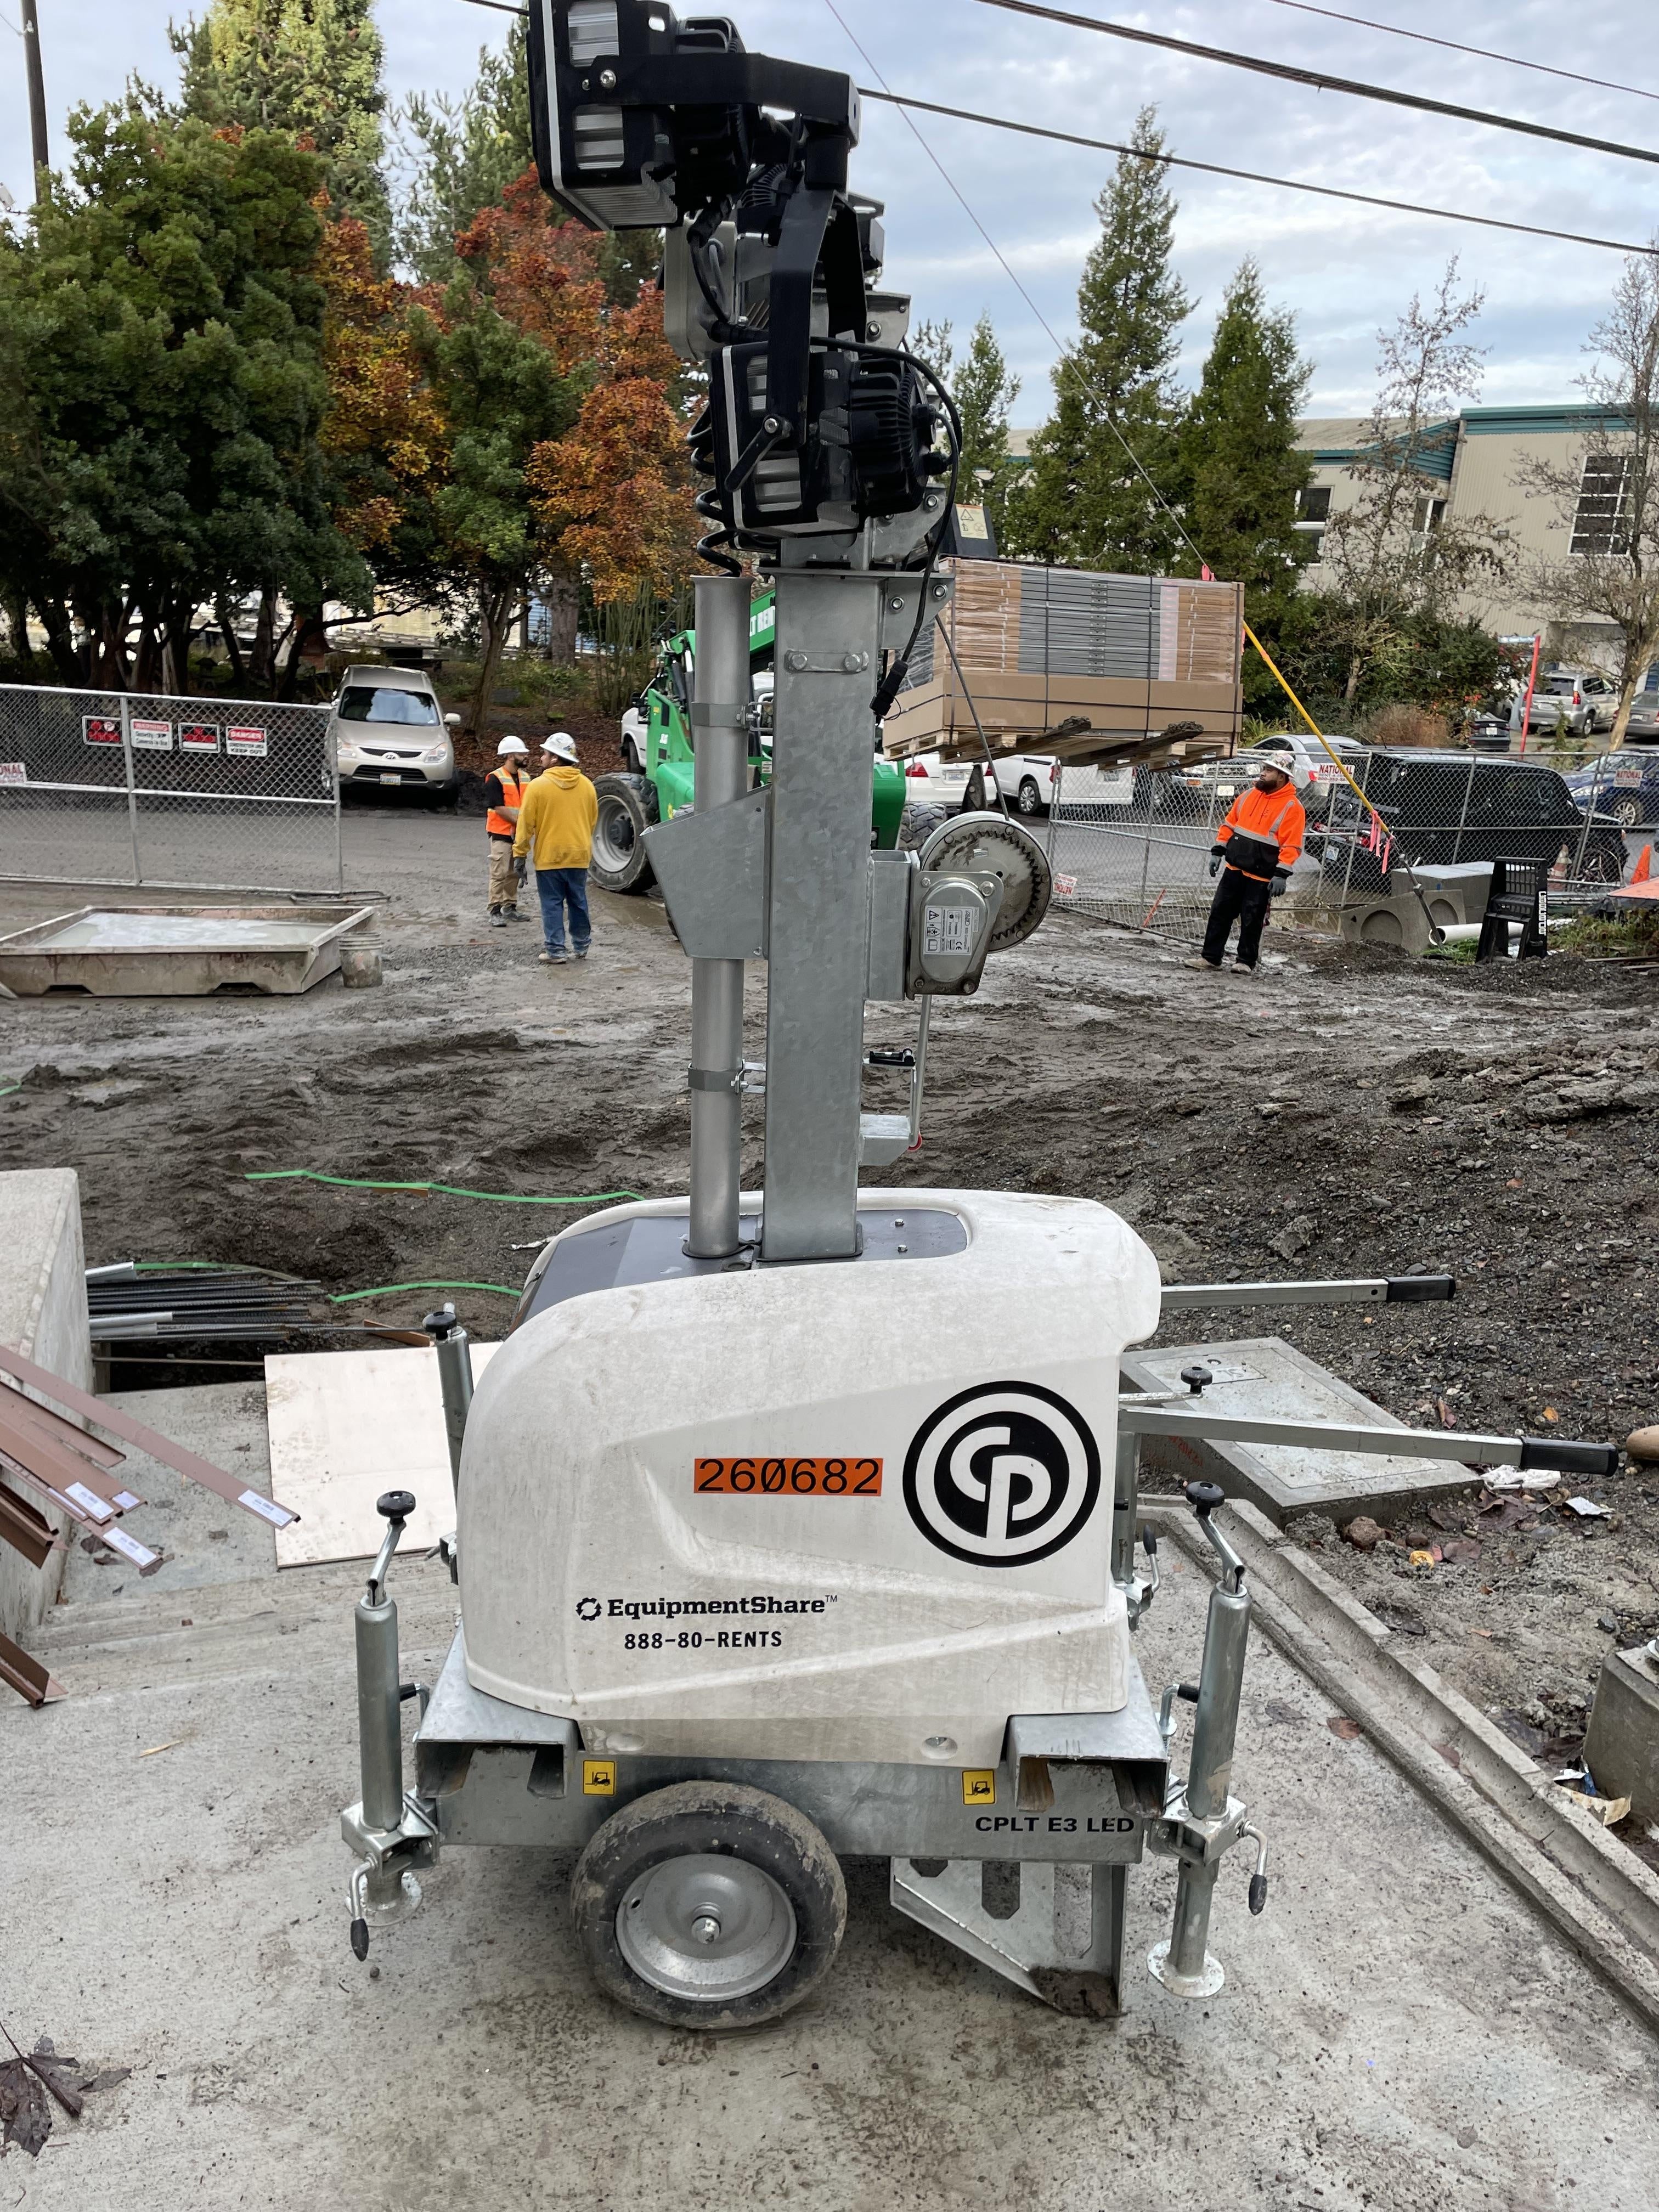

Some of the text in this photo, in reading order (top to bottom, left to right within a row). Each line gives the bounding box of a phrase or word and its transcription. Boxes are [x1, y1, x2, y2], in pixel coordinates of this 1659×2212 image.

[624, 1630, 783, 1650] 888-80-RENTS
[975, 1816, 1135, 1832] CPLT E3 LED
